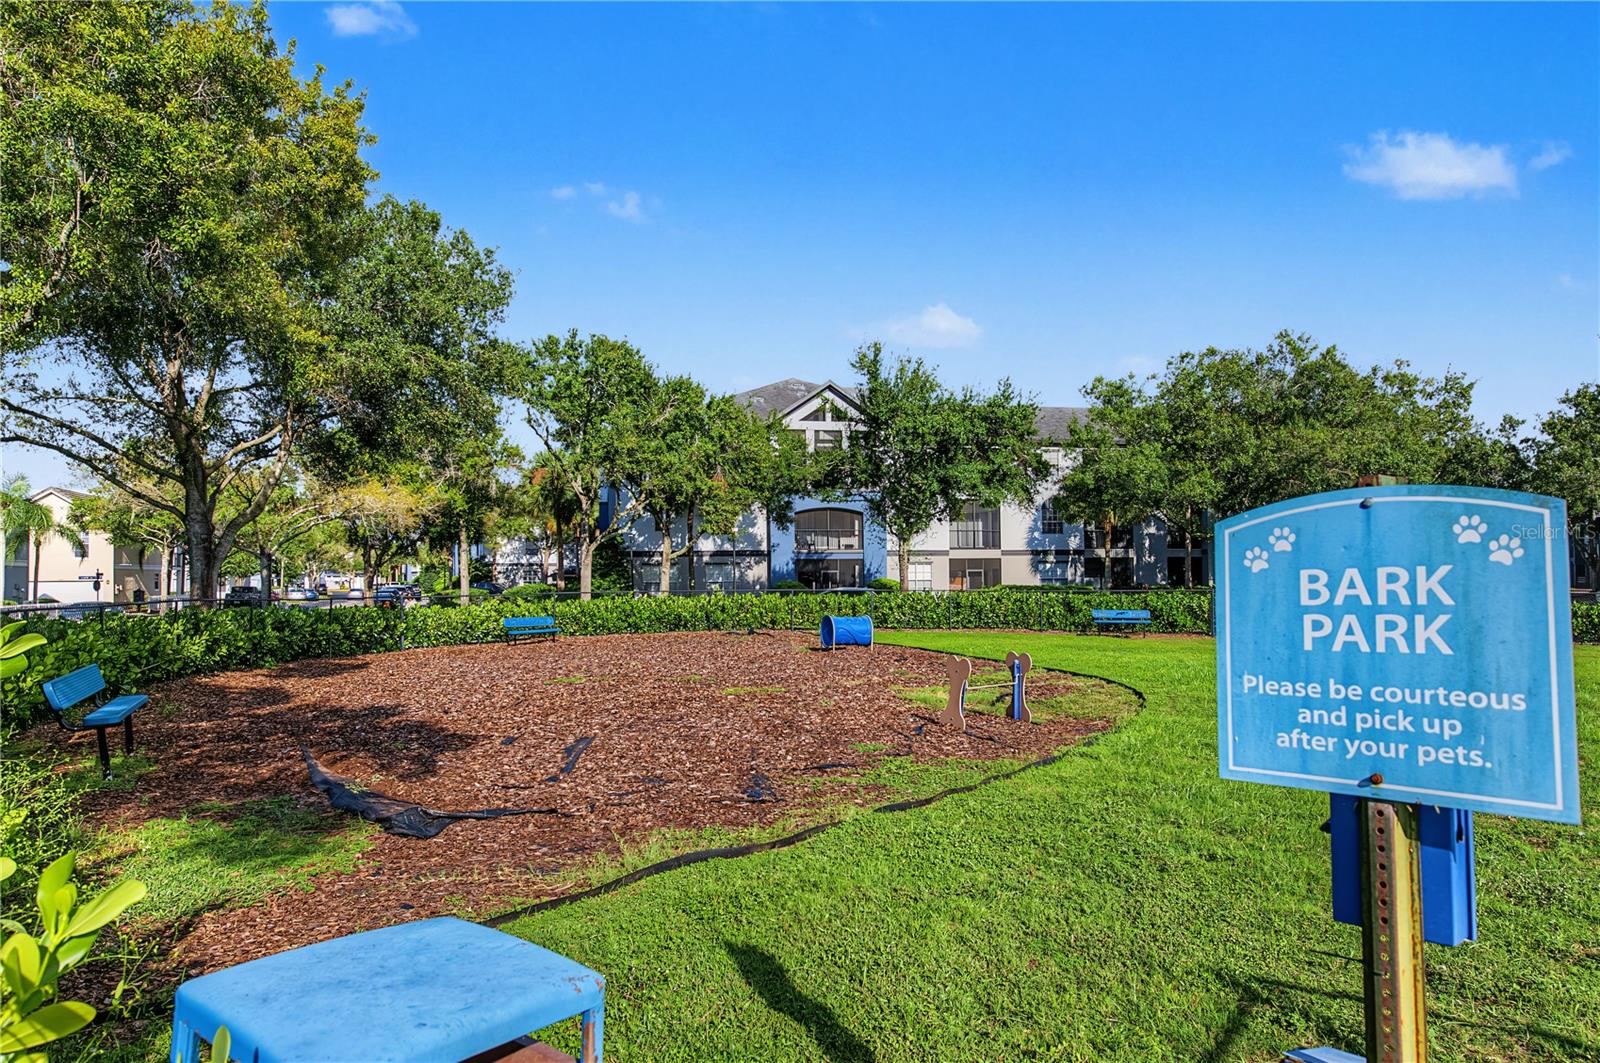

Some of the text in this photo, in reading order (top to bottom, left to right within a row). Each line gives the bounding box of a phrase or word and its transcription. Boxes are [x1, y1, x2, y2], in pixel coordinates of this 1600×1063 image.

[1299, 565, 1455, 607] BARK
[1303, 614, 1454, 655] PARK
[1243, 674, 1527, 711] Please be courteous
[1297, 706, 1463, 739] and pick up
[1276, 729, 1492, 768] after your pets.
